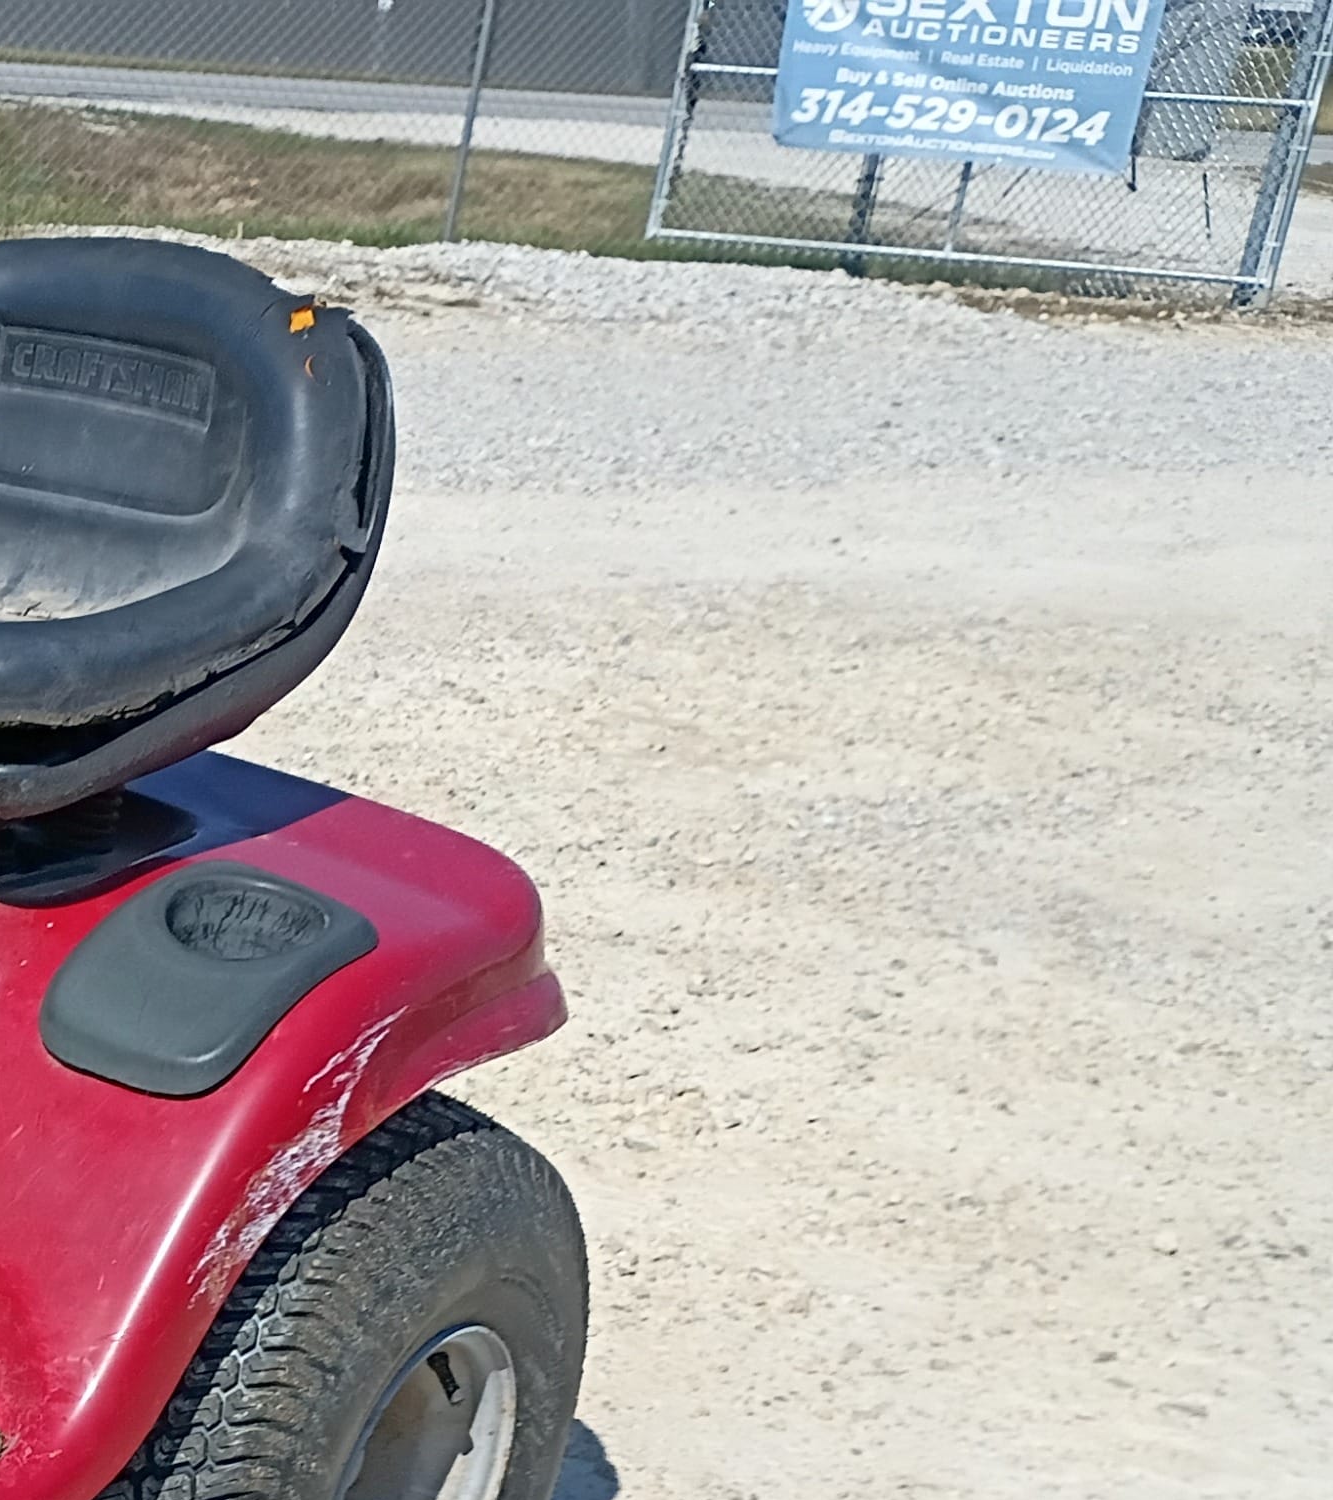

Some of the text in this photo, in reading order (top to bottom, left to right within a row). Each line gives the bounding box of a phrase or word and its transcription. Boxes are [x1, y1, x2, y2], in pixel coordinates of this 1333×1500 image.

[861, 18, 1140, 54] AUCTIONEERS
[793, 40, 1133, 76] Heavy Equipment Real Estate Liquidation
[835, 67, 1076, 101] Buy & Sell Online Auctions
[790, 88, 1110, 146] 314-529-0124
[12, 341, 200, 412] CRAFTSMAN
